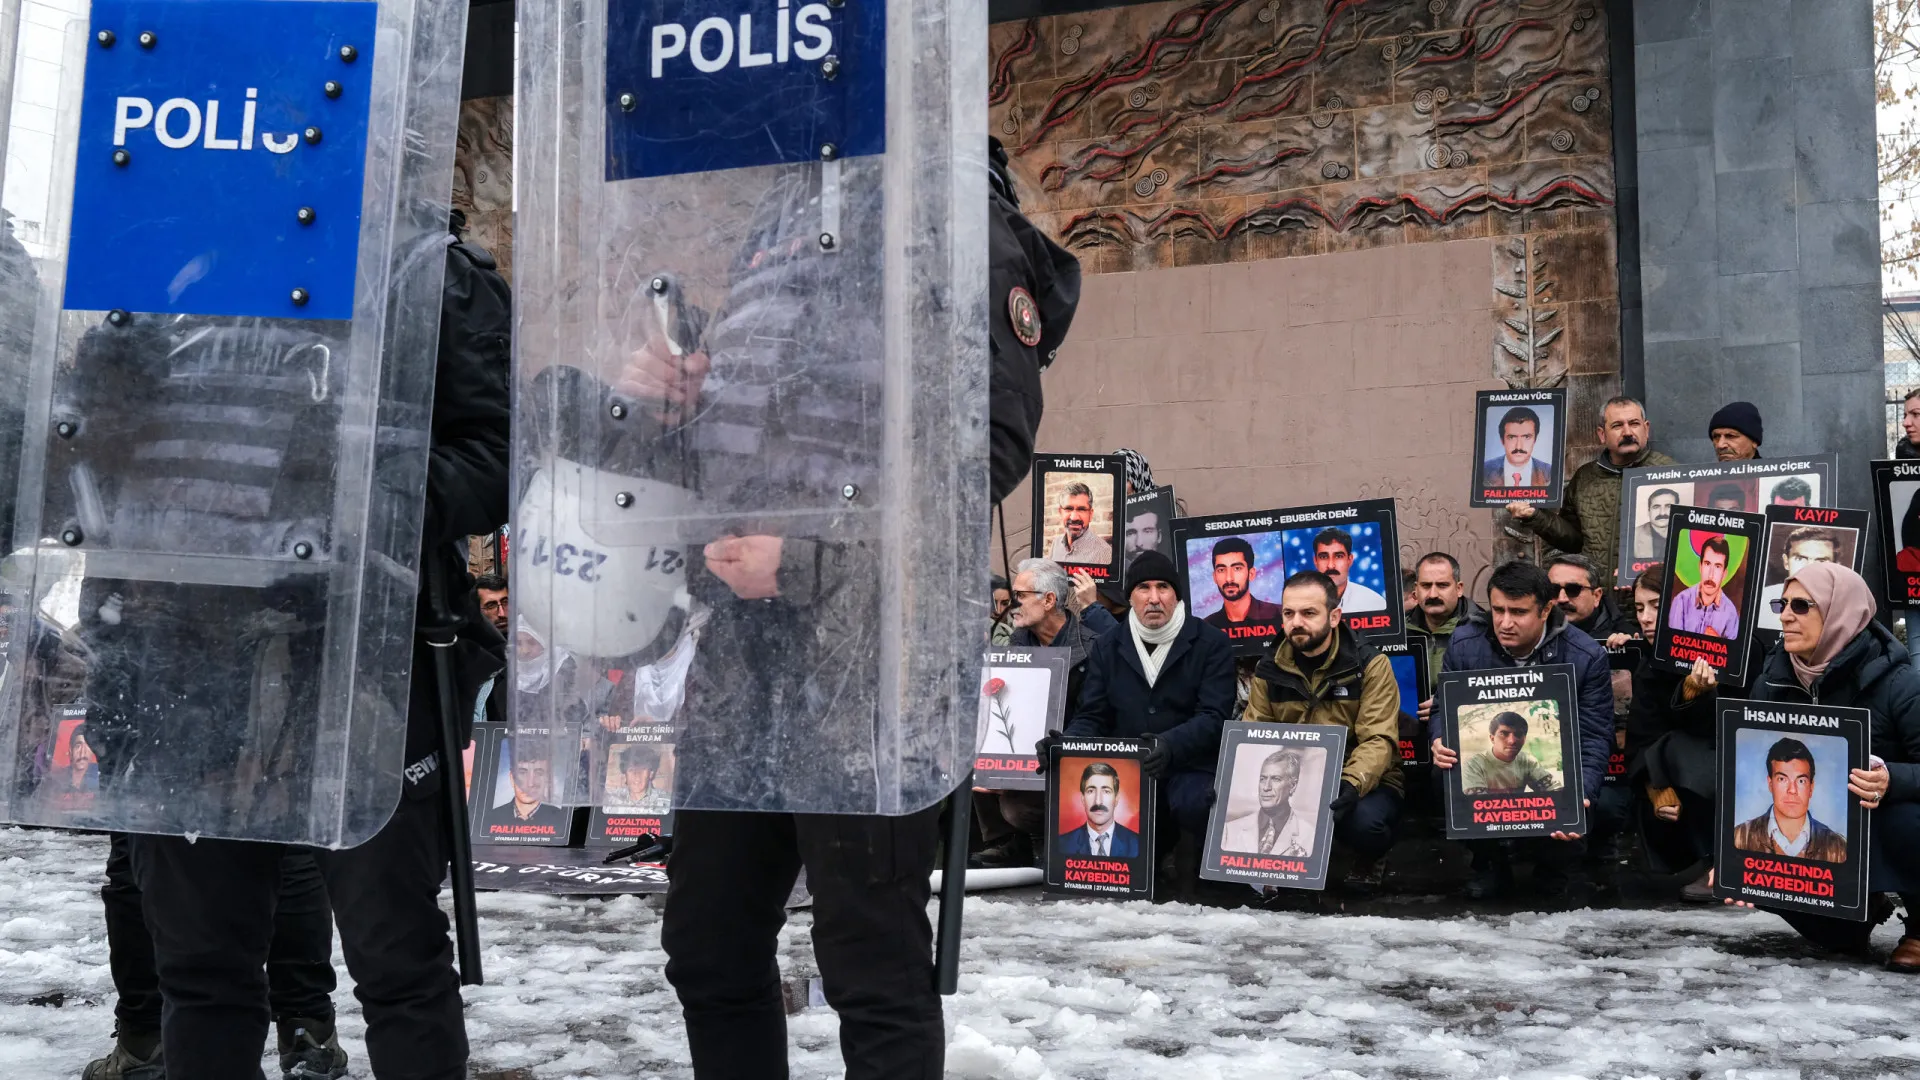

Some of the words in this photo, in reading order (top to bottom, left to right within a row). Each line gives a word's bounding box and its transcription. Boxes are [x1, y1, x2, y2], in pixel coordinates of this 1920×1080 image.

[652, 0, 832, 78] POLİS
[1490, 393, 1529, 401] RAMAZAN
[1530, 391, 1552, 400] YÜCE
[1054, 457, 1081, 468] TAHİR
[1083, 458, 1104, 470] ELÇİ
[1646, 469, 1681, 480] TAHSİN
[1689, 467, 1721, 479] ÇAYAN
[1729, 464, 1746, 475] ALİ
[1747, 463, 1777, 474] İHSAN
[1780, 461, 1810, 471] ÇİÇEK
[1138, 491, 1158, 502] AYŞİN
[1205, 519, 1243, 531] SERDAR
[1244, 517, 1273, 528] TANIŞ
[1280, 510, 1327, 524] EBUBEKİR
[1329, 507, 1358, 518] DENİZ
[1688, 510, 1716, 526] ÖMER
[1717, 513, 1745, 529] ÖNER
[1794, 508, 1839, 523] KAYIP
[983, 652, 1005, 662] VET
[1006, 651, 1032, 663] İPEK
[1468, 670, 1543, 687] FAHRETTİN
[1477, 687, 1536, 700] ALINBAY
[63, 707, 87, 717] İBRAHİ
[1743, 706, 1786, 723] İHSAN
[1788, 714, 1839, 728] HARAN
[1247, 729, 1280, 740] MUSA
[1282, 731, 1321, 741] ANTER
[1062, 742, 1102, 751] MAHMUT
[1104, 742, 1138, 752] DOĞAN
[1473, 809, 1557, 823] KAYBEDİLDİ
[1065, 870, 1130, 885] KAYBEDİLDİ
[1226, 868, 1258, 877] DİYARBAKIR
[1064, 881, 1093, 890] DİYARBAKIR
[1743, 871, 1834, 898] KAYBEDİLDİ
[1741, 886, 1781, 900] DİYARBAKIR
[1794, 896, 1818, 906] ARALIK
[1819, 899, 1835, 908] 1994
